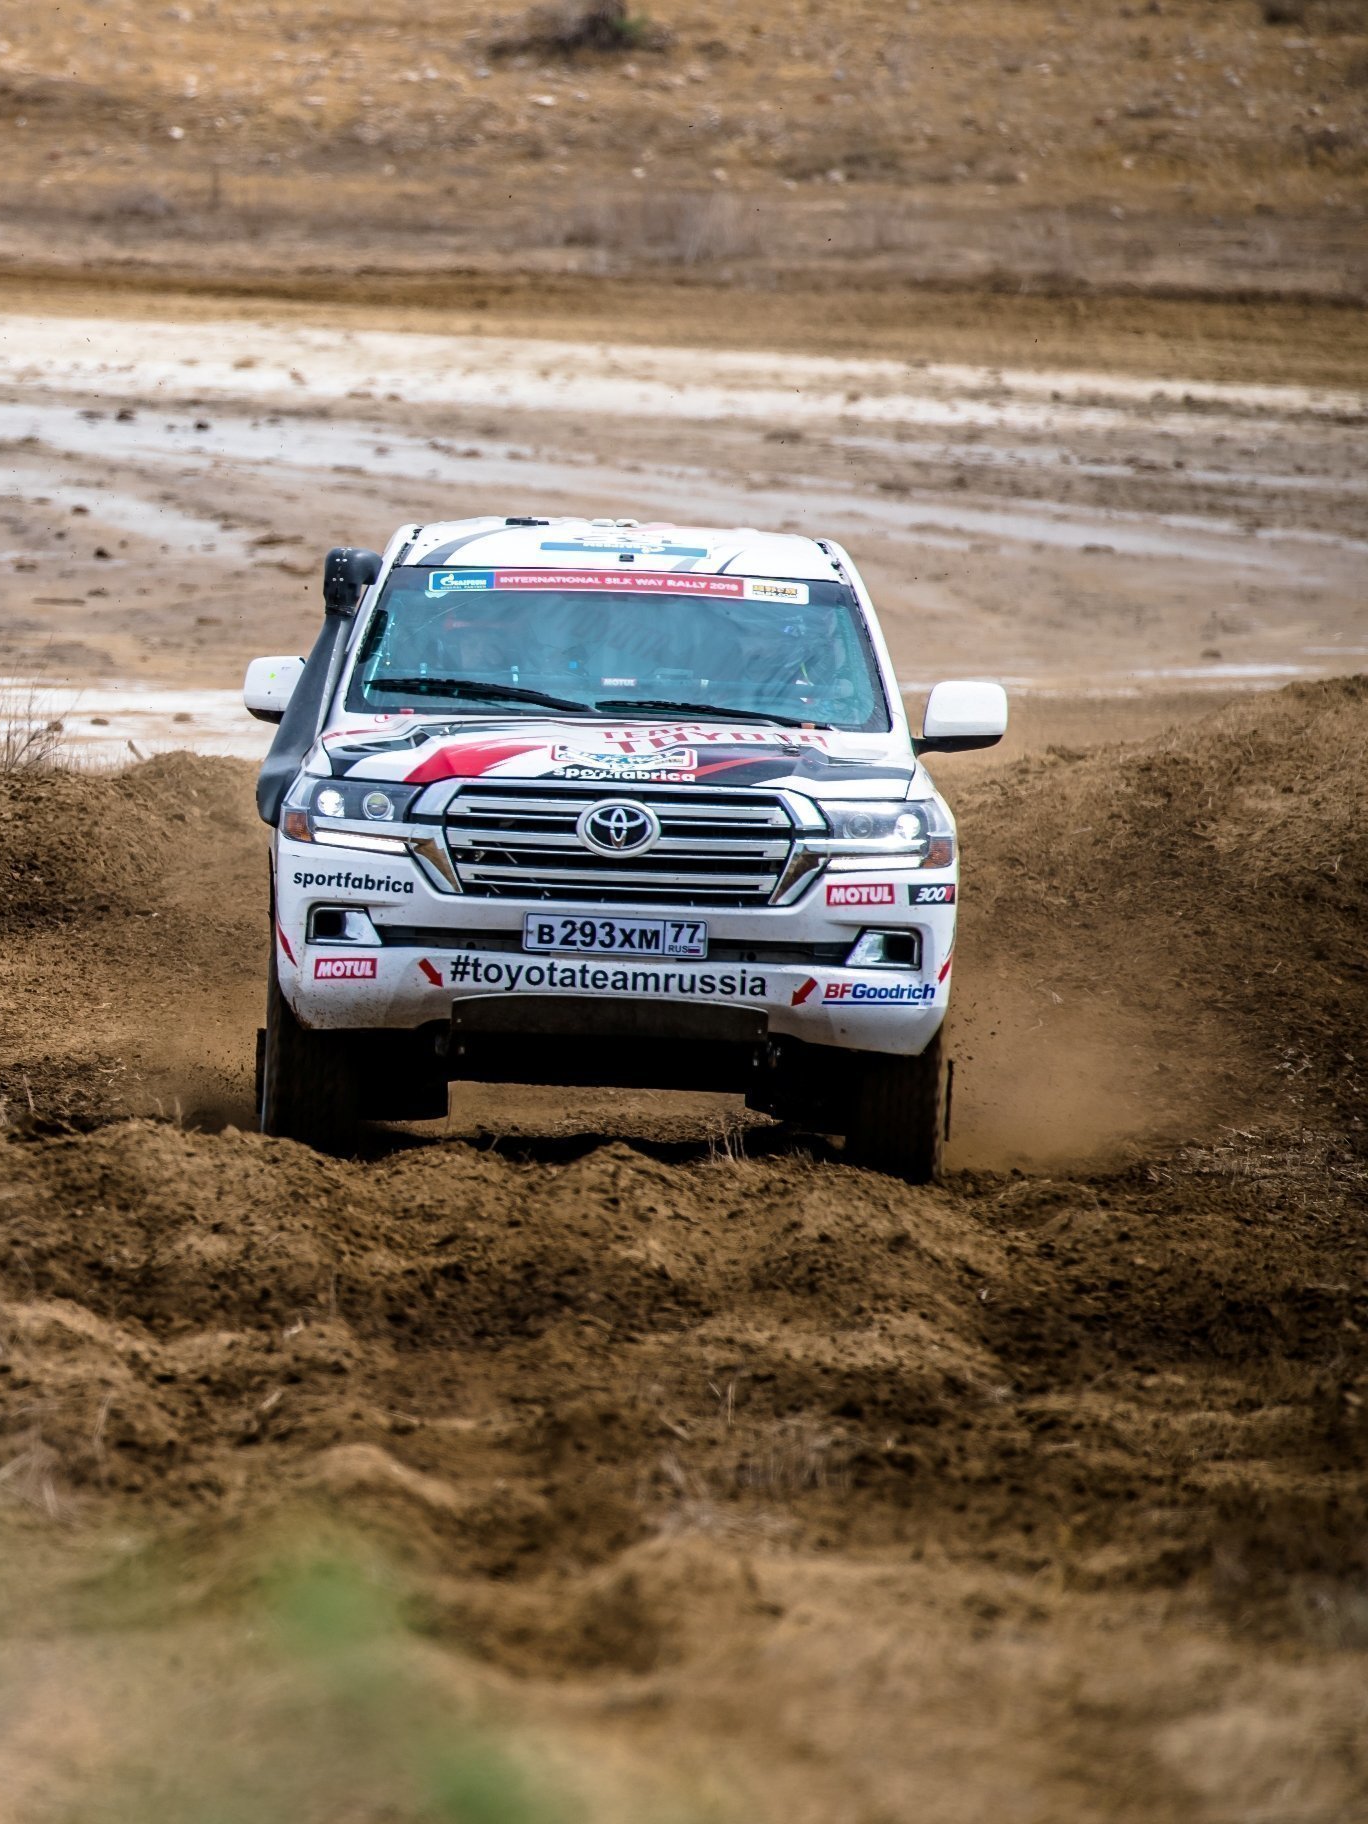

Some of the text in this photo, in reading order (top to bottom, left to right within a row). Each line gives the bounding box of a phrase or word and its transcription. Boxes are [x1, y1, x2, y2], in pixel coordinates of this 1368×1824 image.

[499, 576, 600, 585] INTERNATIONAL
[604, 577, 633, 585] SILK
[635, 578, 665, 587] WAY
[667, 579, 708, 589] RALLY
[603, 678, 636, 687] MOTUL
[604, 732, 829, 754] TOYOTA
[293, 870, 414, 894] sportfabrica
[828, 885, 893, 903] MOTUL
[669, 923, 700, 944] 77
[668, 944, 688, 954] RUS
[316, 960, 374, 977] MOTUL
[450, 954, 768, 997] #toyotateamrussia
[823, 983, 936, 1000] BFGoodrich
